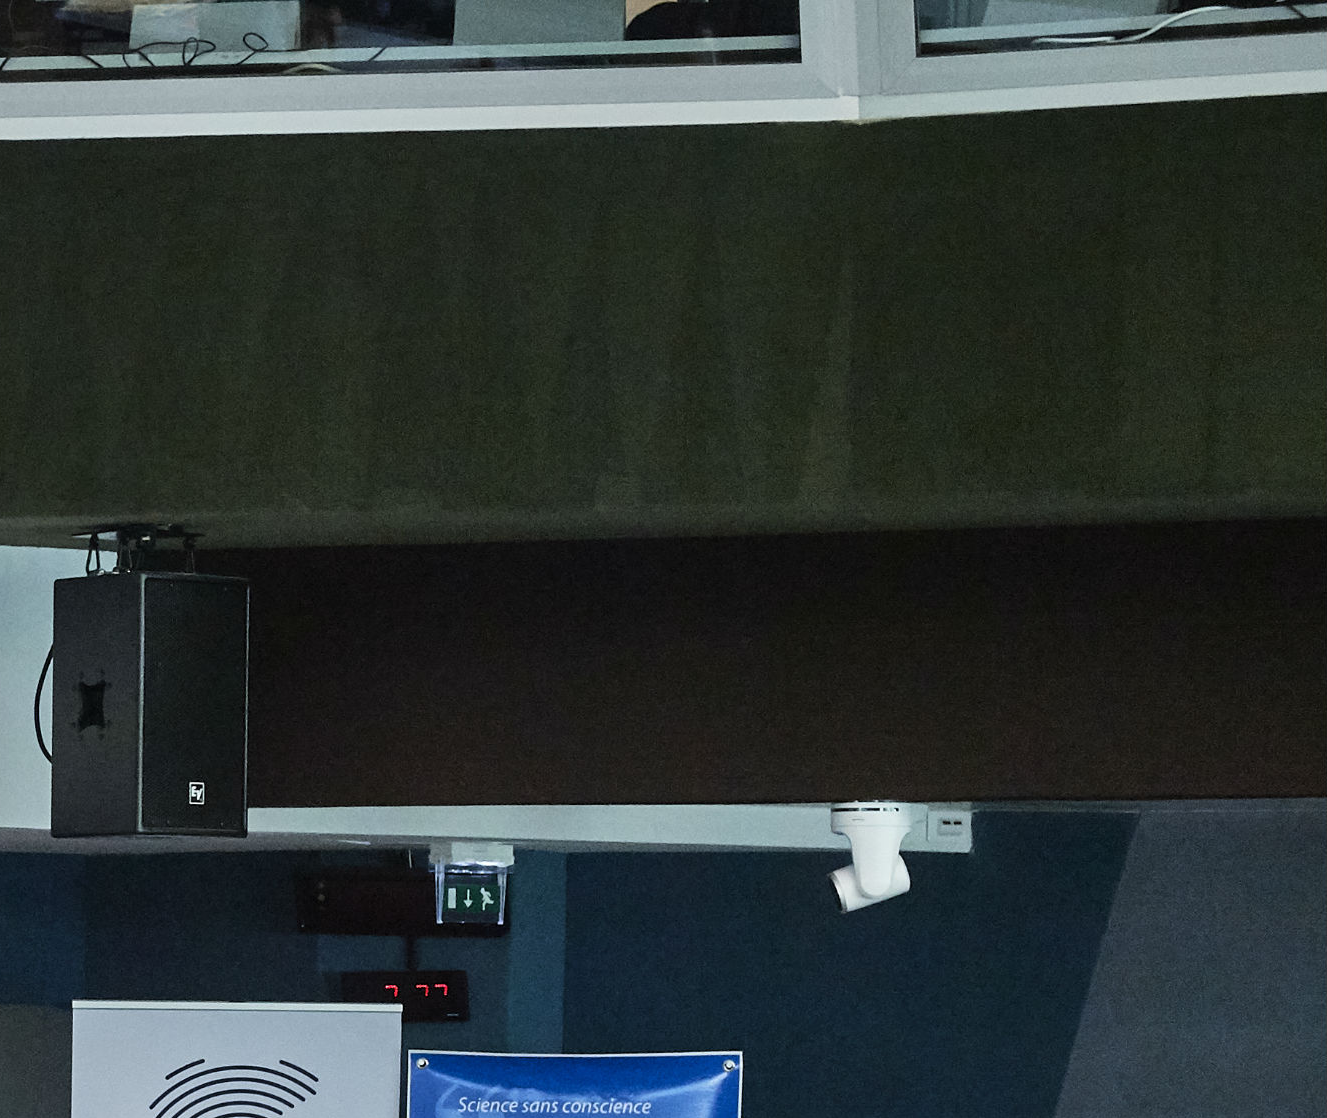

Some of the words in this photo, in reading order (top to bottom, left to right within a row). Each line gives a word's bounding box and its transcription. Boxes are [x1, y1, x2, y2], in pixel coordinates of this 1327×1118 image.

[457, 1096, 518, 1114] Science
[521, 1100, 559, 1114] sans
[562, 1099, 652, 1115] conscience
